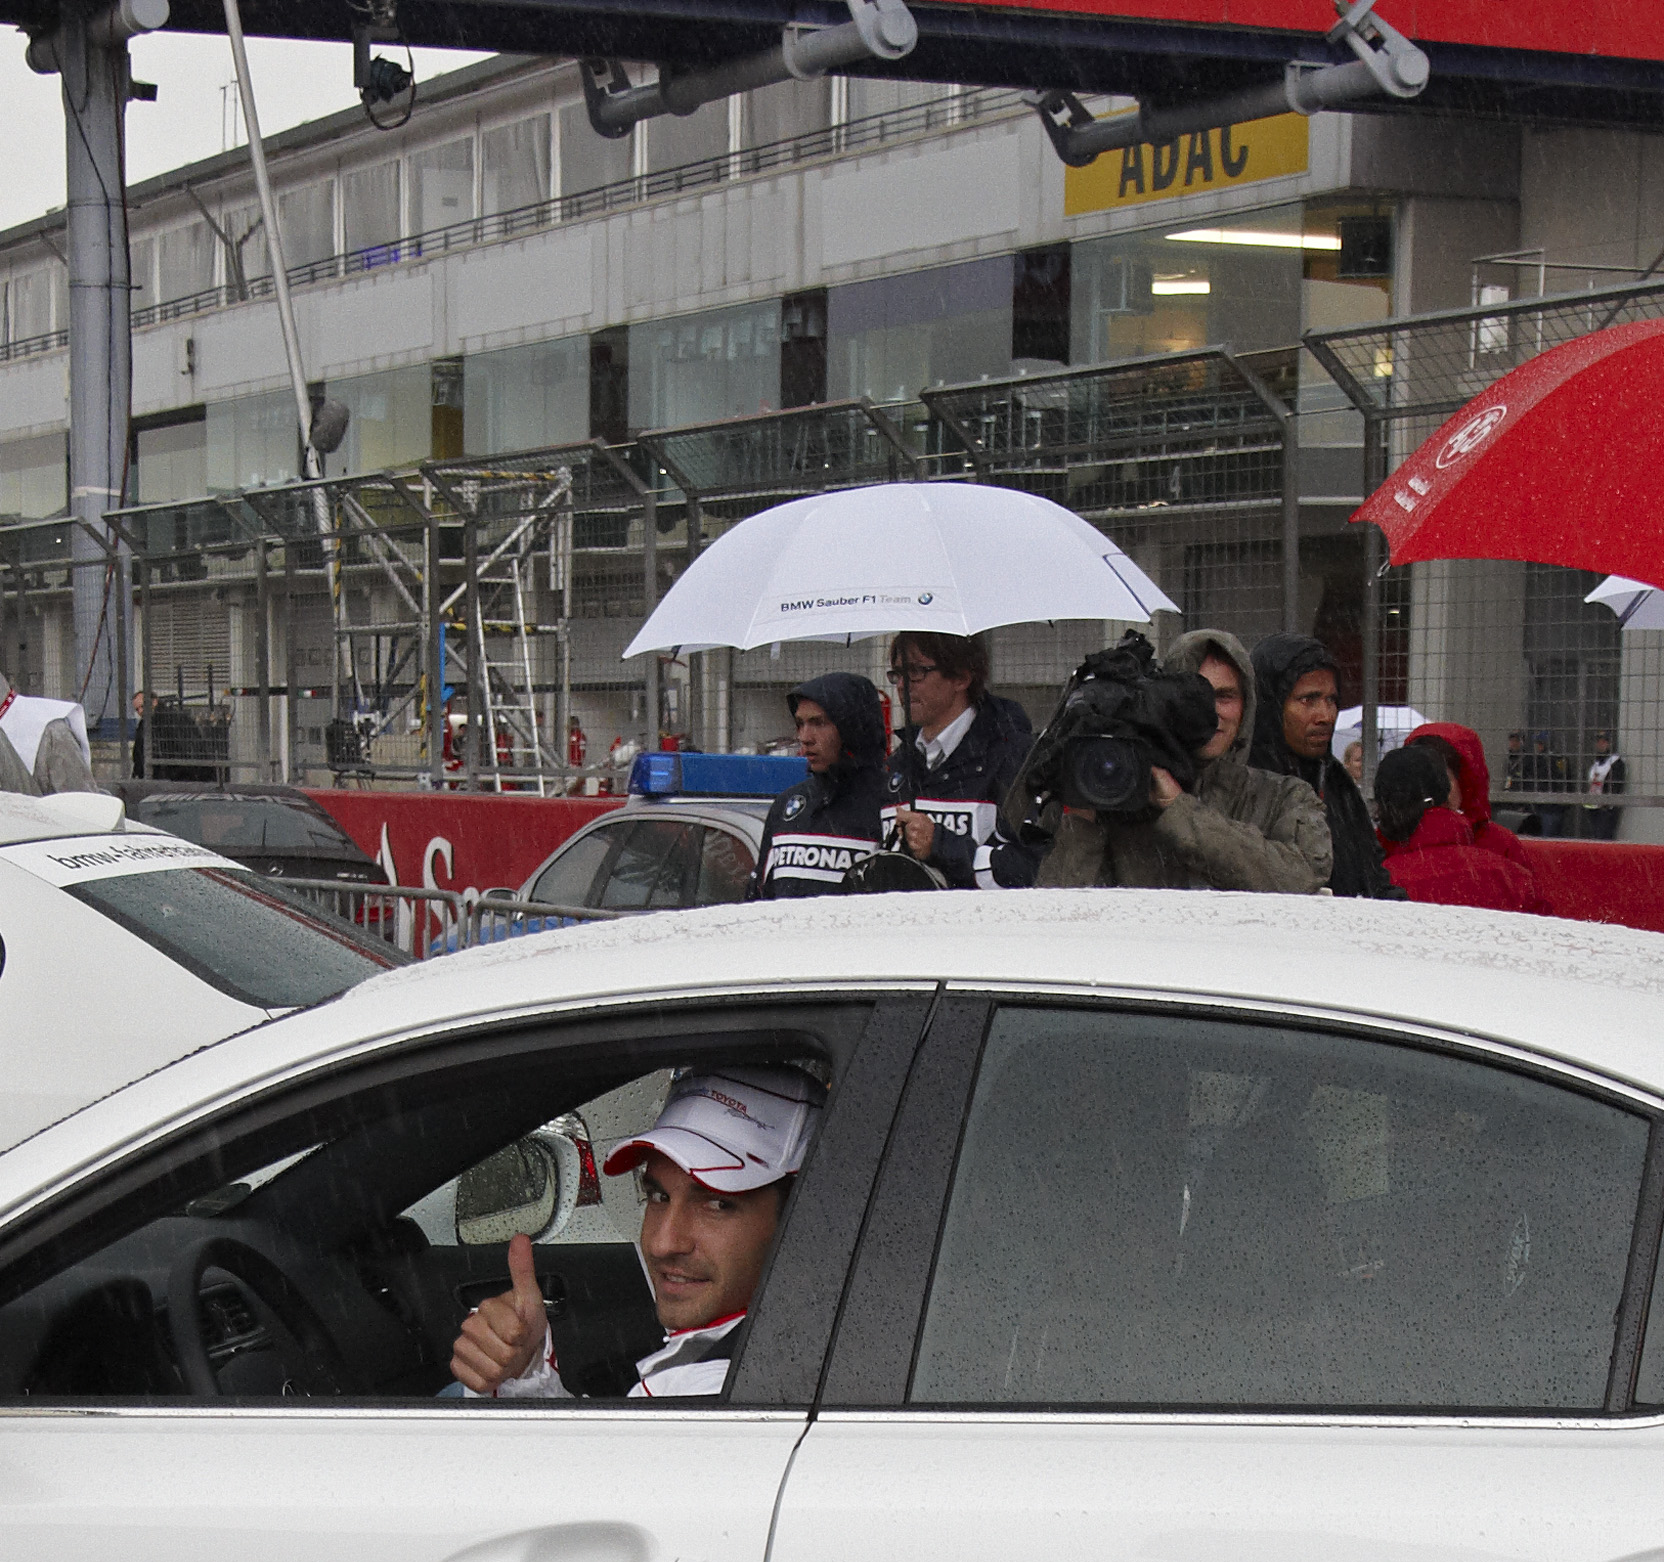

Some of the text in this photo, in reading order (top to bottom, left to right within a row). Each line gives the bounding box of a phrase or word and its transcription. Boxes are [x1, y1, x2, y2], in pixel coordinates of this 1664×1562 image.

[1119, 127, 1248, 198] ADAC
[780, 595, 911, 612] BMW Sauber F1 Team
[711, 1089, 748, 1114] TOYOTA
